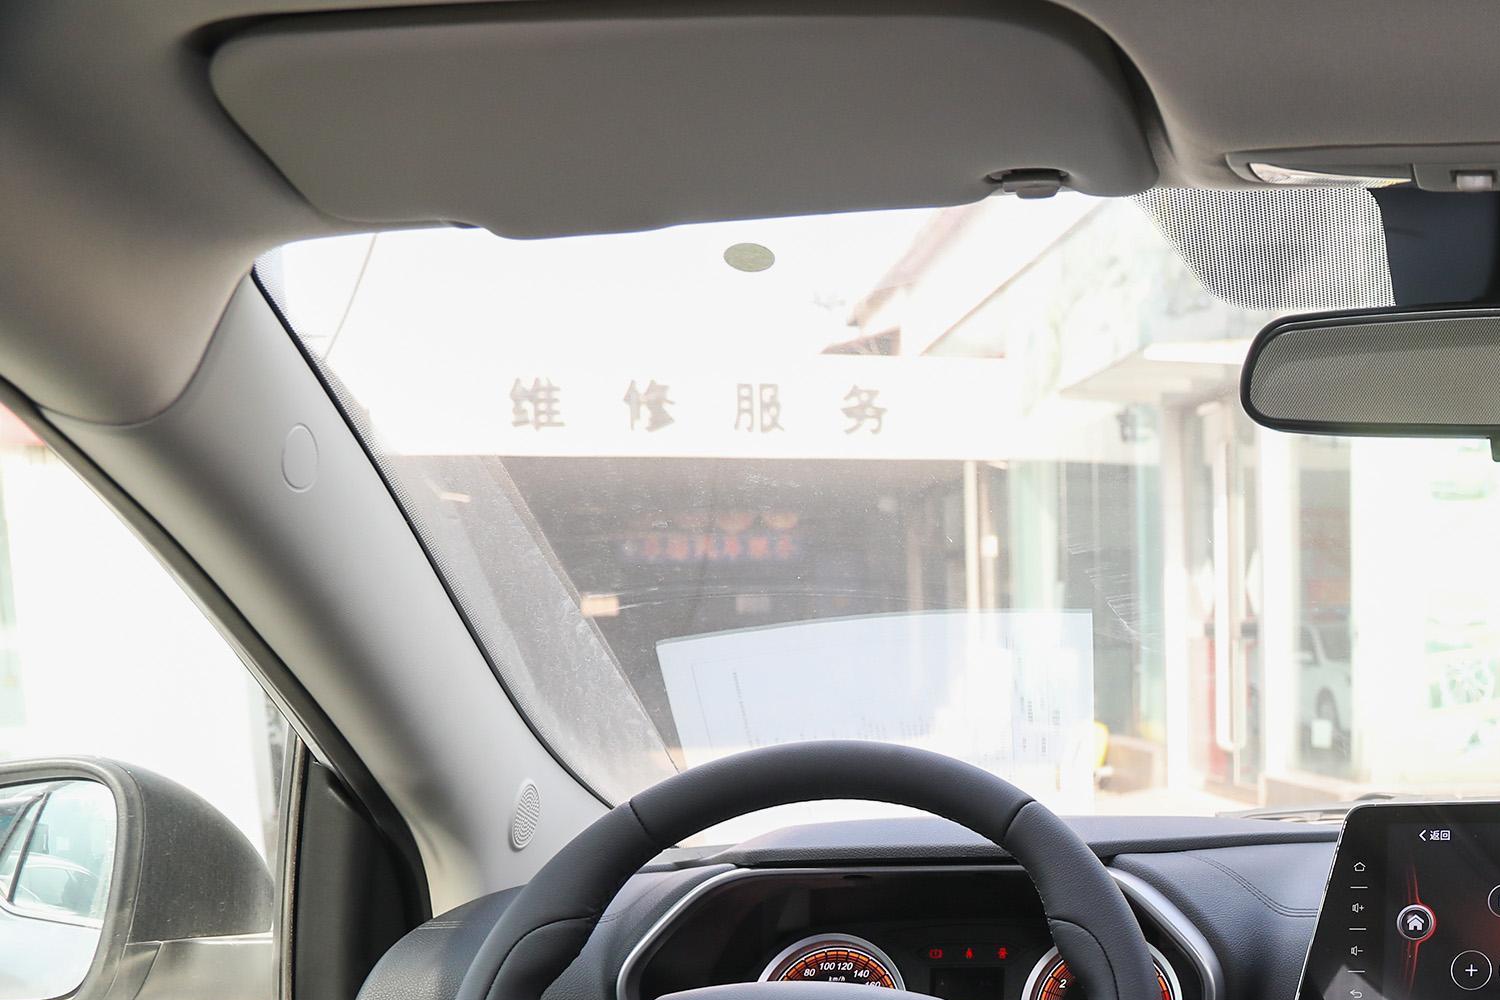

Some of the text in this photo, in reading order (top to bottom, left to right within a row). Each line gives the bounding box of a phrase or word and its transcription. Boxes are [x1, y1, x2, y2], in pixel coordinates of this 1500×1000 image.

[509, 376, 889, 434] 维修服务
[1430, 830, 1450, 840] 返回
[820, 963, 835, 971] 100
[837, 963, 853, 971] 120
[804, 968, 815, 977] 80
[853, 970, 869, 978] 140
[1059, 979, 1066, 988] 2
